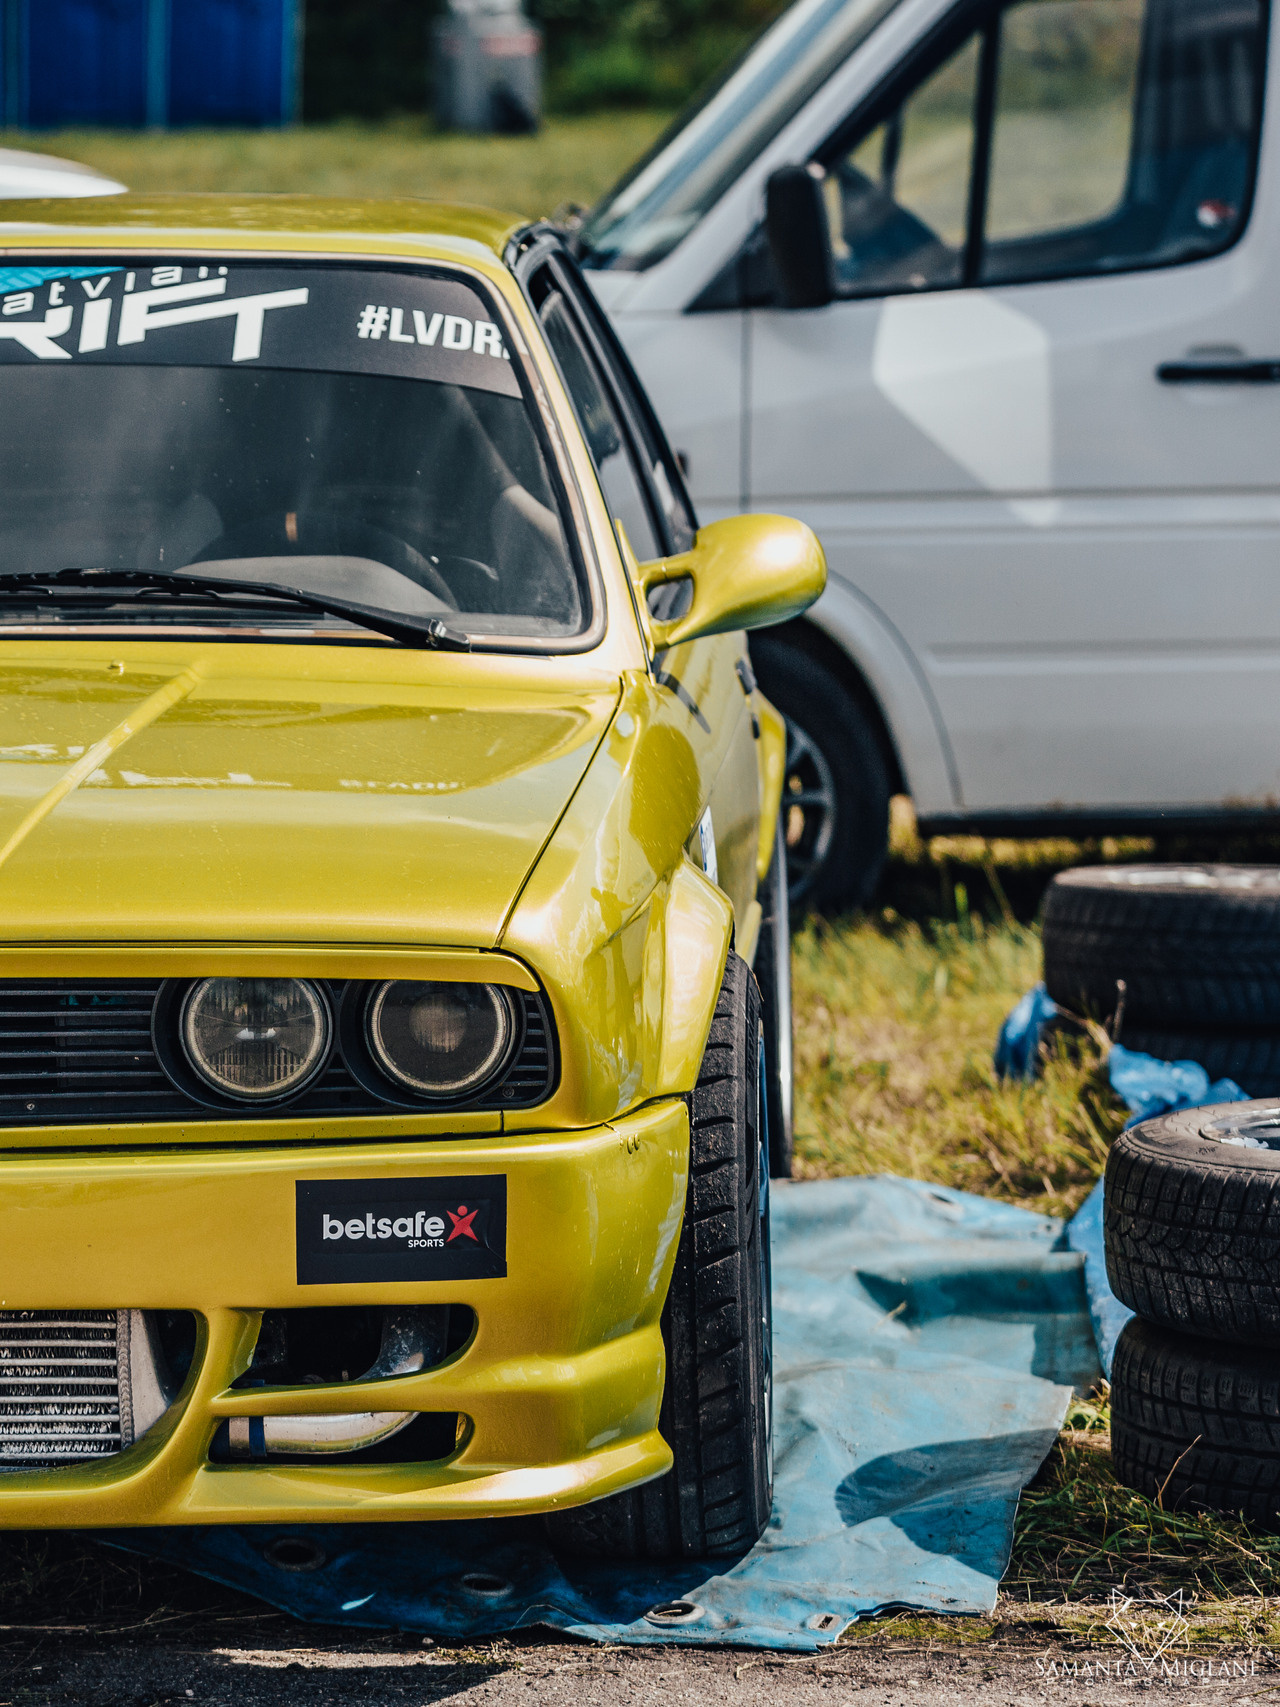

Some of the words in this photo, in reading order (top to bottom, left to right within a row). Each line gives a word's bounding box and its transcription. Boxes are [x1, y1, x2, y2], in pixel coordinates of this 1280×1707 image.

[356, 304, 511, 360] #LVDR
[322, 1211, 445, 1240] betsafe
[408, 1238, 445, 1248] SPORTS
